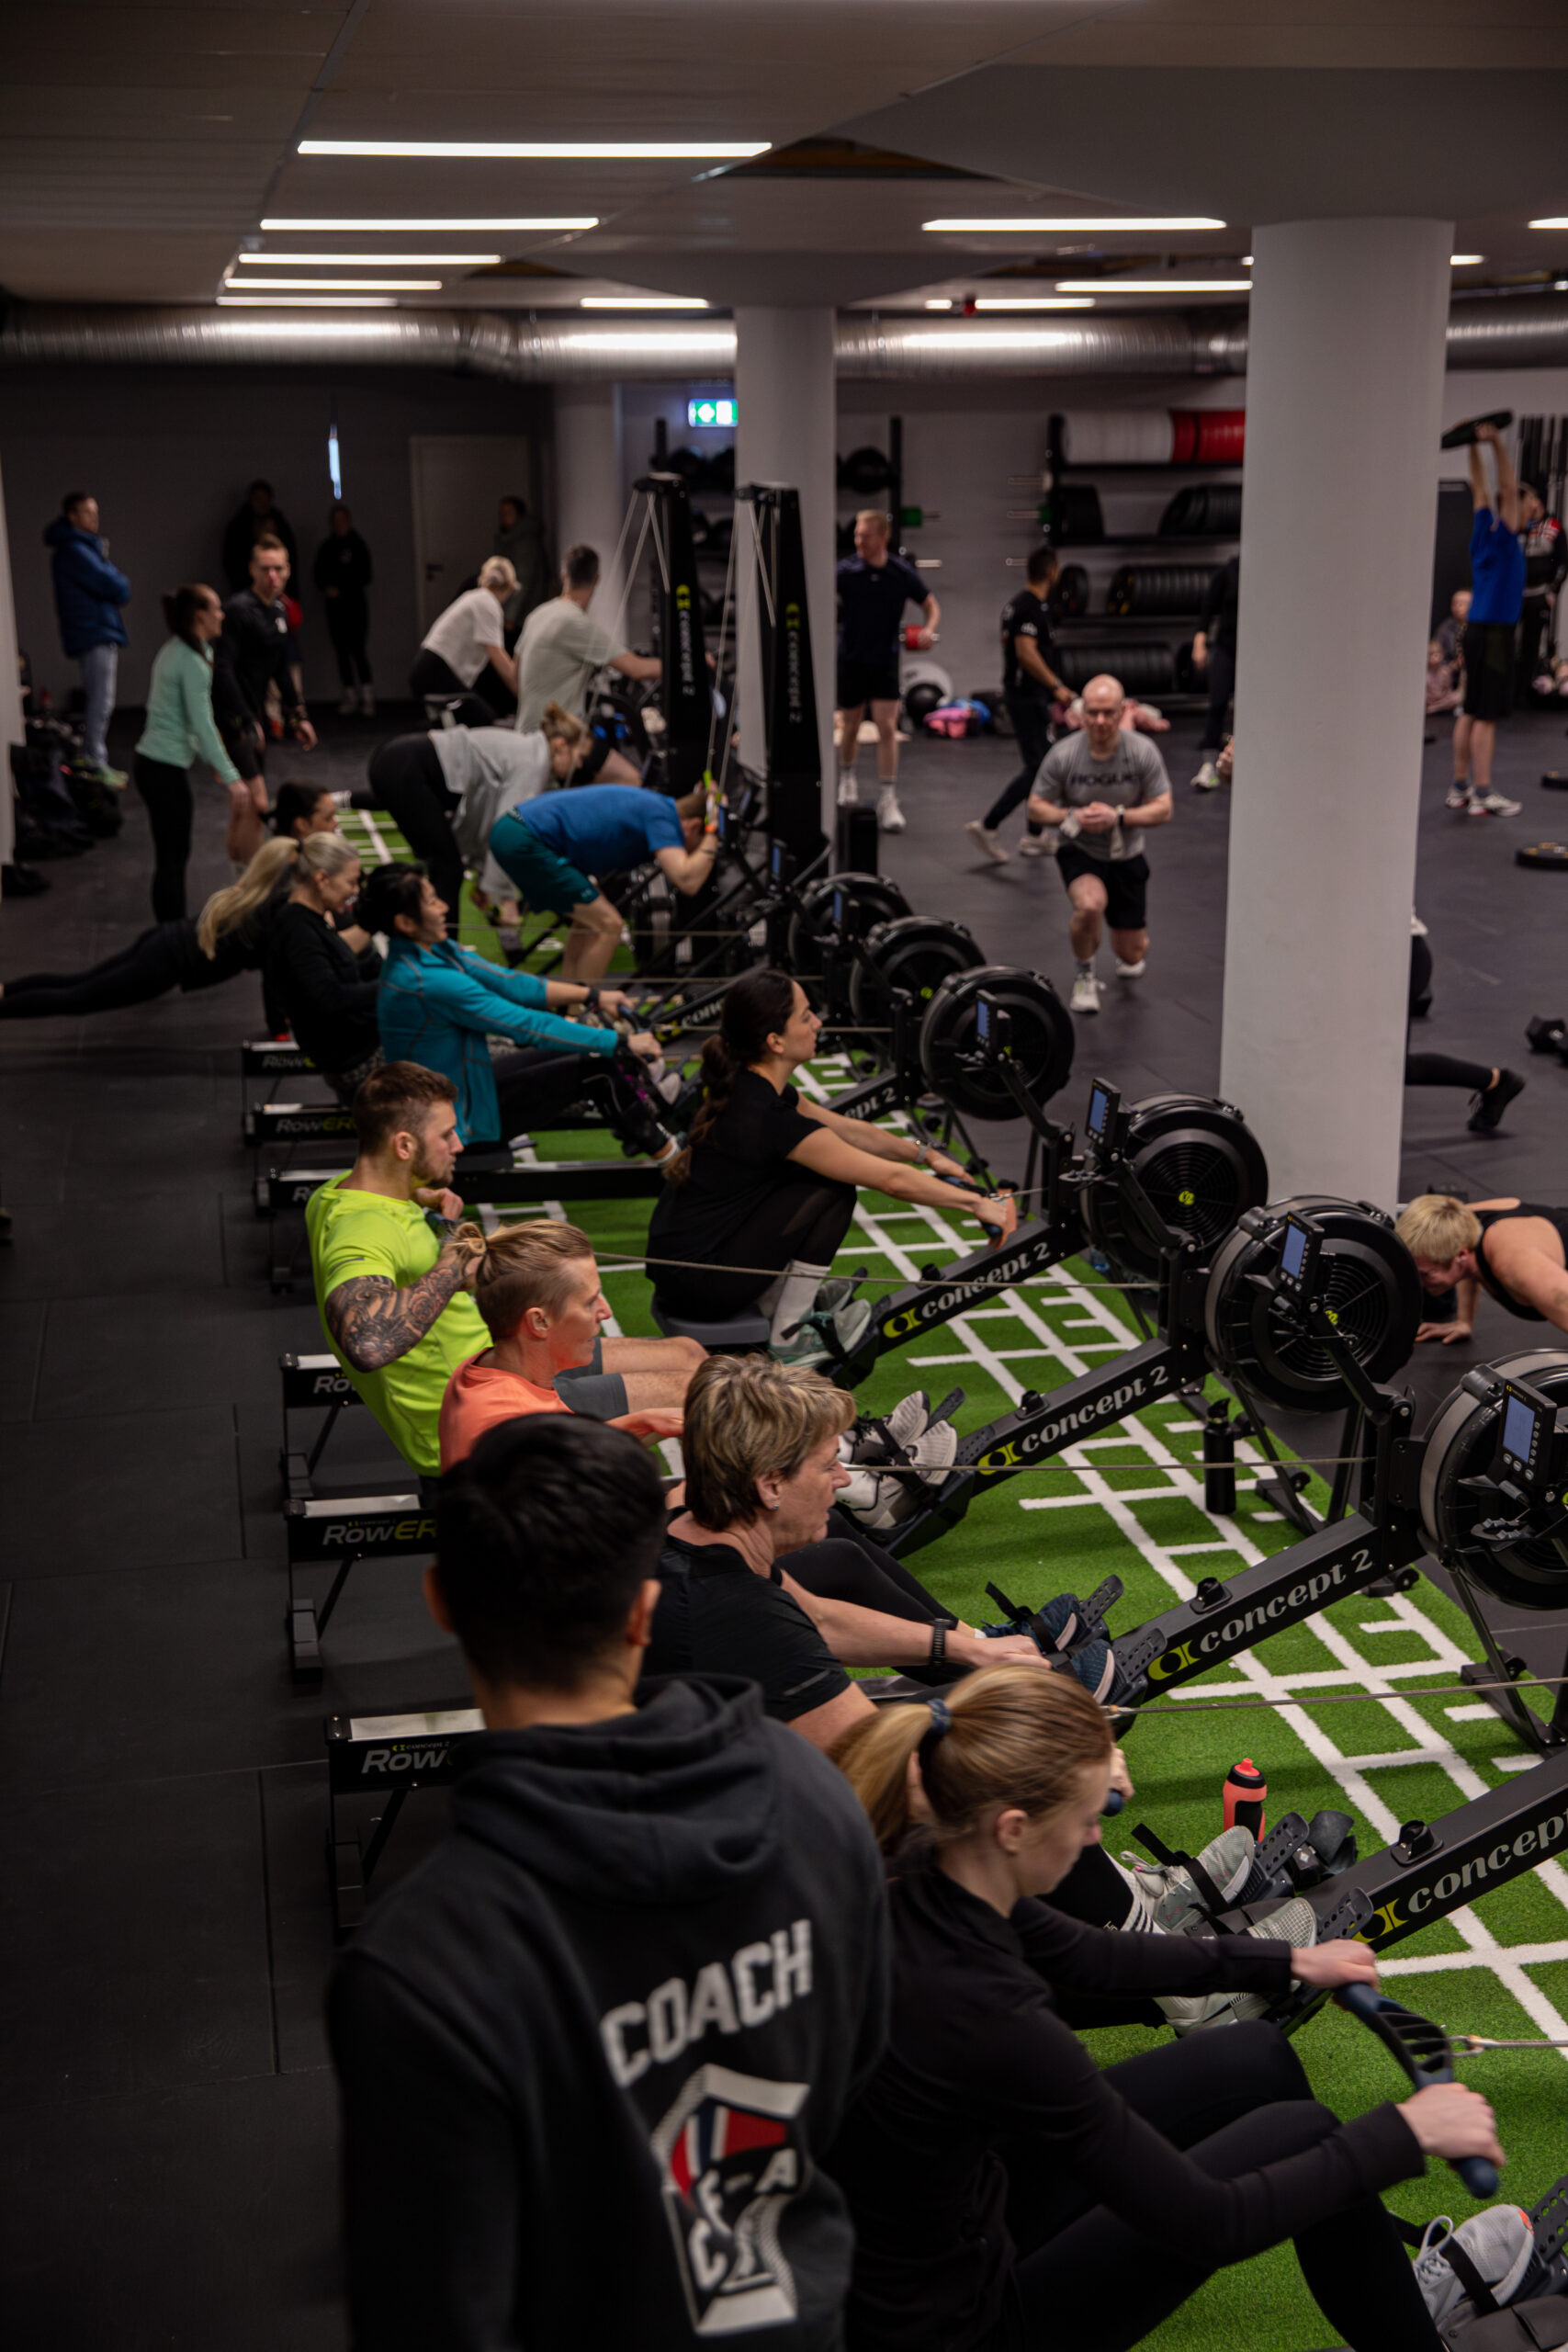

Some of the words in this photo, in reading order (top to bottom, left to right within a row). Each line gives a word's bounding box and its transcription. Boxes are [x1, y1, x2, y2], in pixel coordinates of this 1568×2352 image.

[275, 1115, 358, 1135] RowER
[882, 1086, 897, 1103] 2
[921, 1251, 1032, 1318] concept
[1032, 1241, 1052, 1261] 2
[1021, 1377, 1147, 1453] concept
[1149, 1365, 1169, 1386] 2
[321, 1519, 439, 1546] RowER
[1200, 1563, 1347, 1653] concept
[1351, 1548, 1374, 1574] 2
[600, 1917, 813, 2089] COACH
